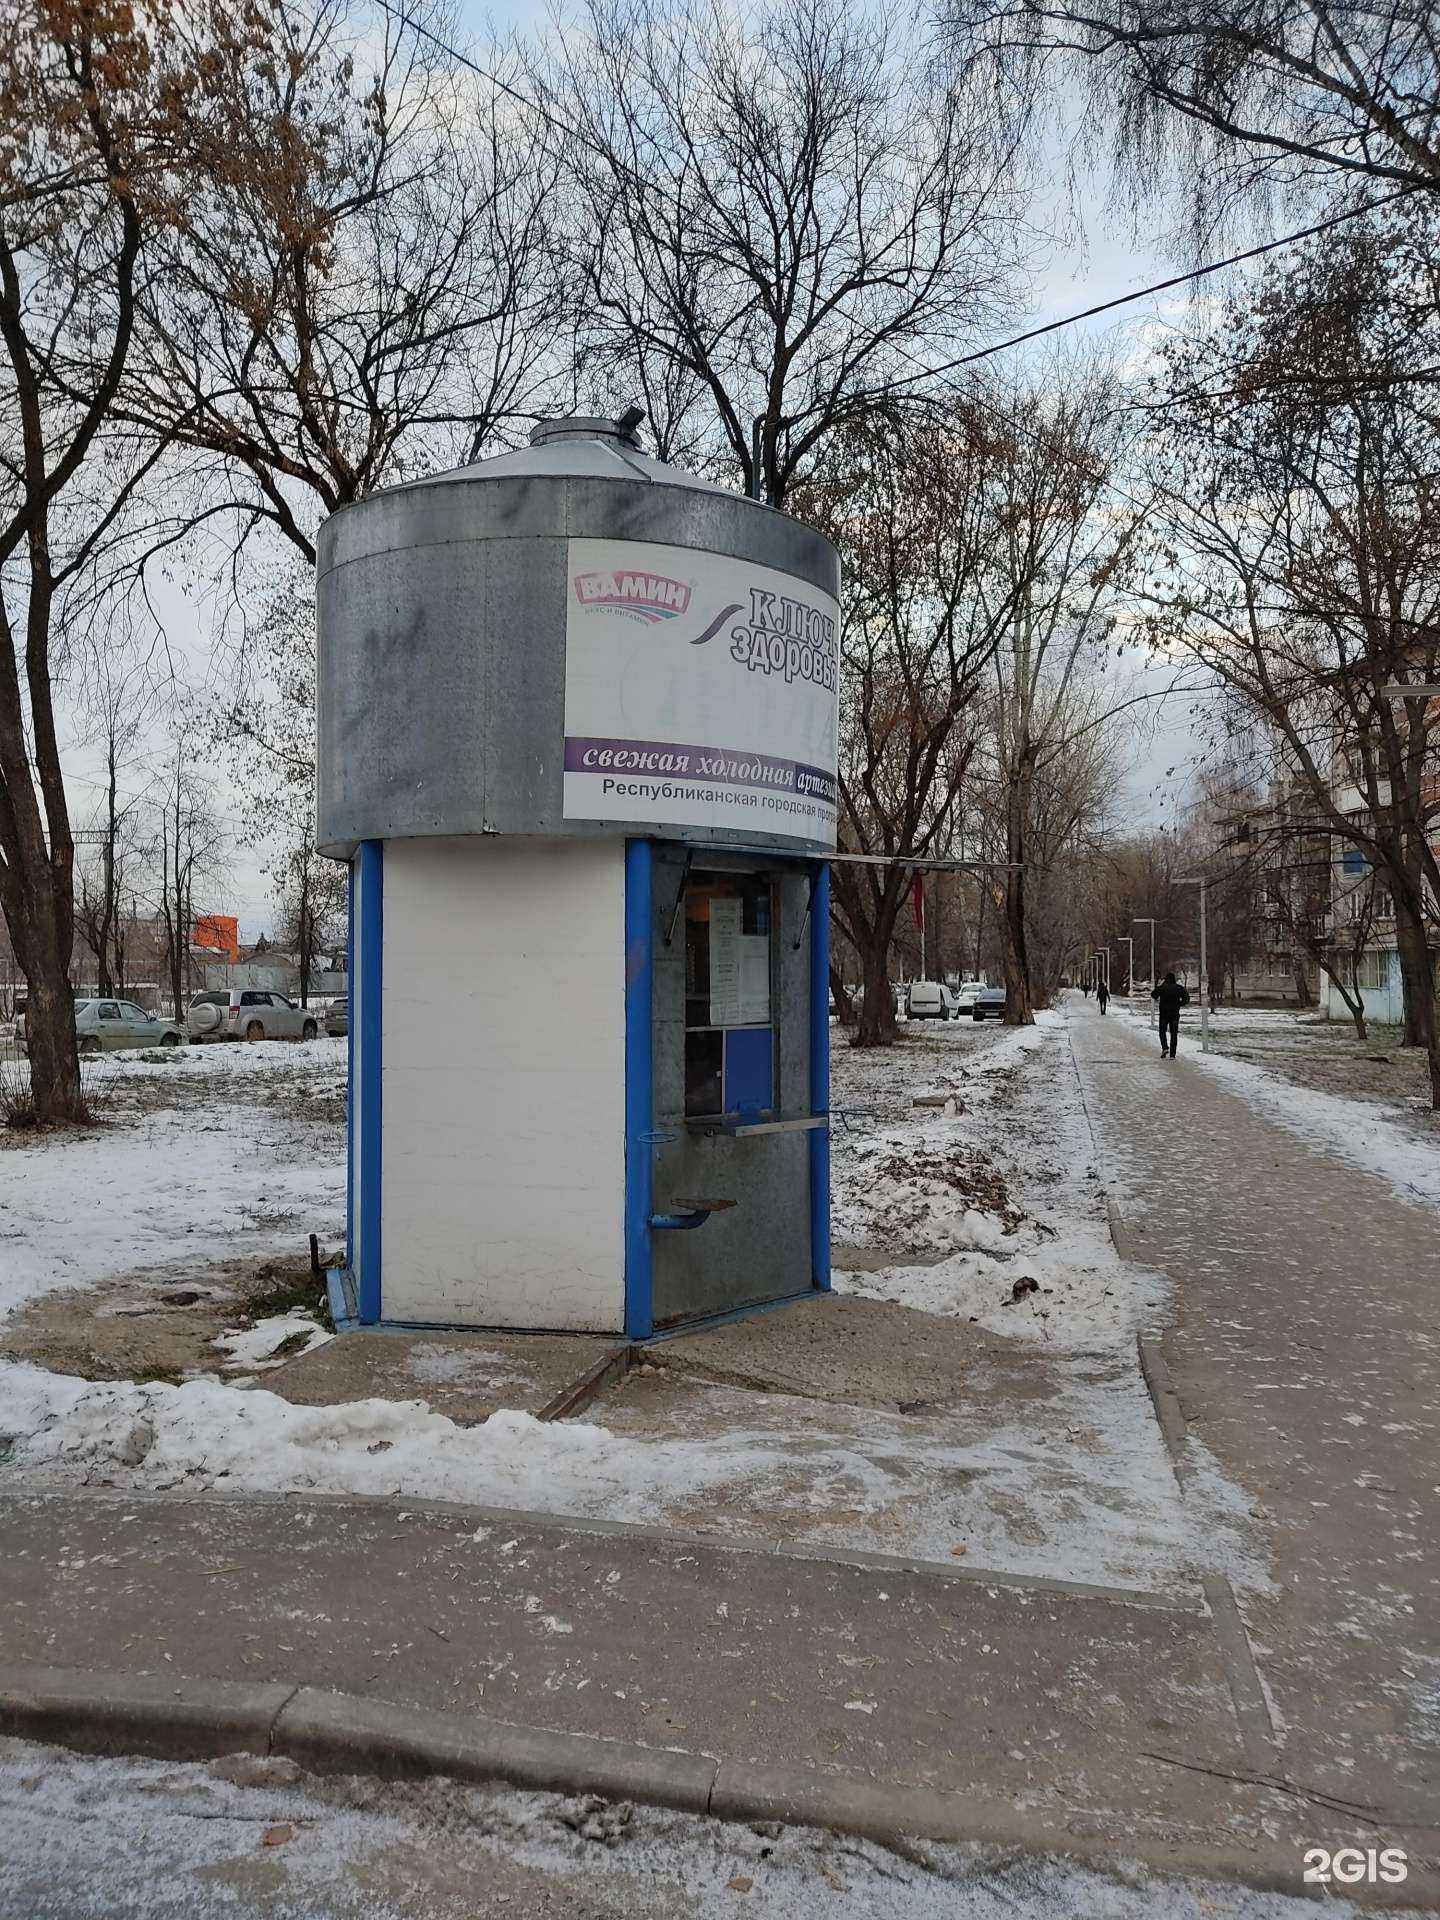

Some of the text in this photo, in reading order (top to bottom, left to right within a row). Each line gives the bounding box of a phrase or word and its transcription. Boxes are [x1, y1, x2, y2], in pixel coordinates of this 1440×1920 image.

[580, 575, 685, 608] ВАМИН
[749, 588, 835, 657] КЛЮЧ
[582, 747, 689, 774] свежая
[695, 755, 795, 787] холодная
[602, 778, 758, 807] Республиканская
[761, 795, 816, 817] городская
